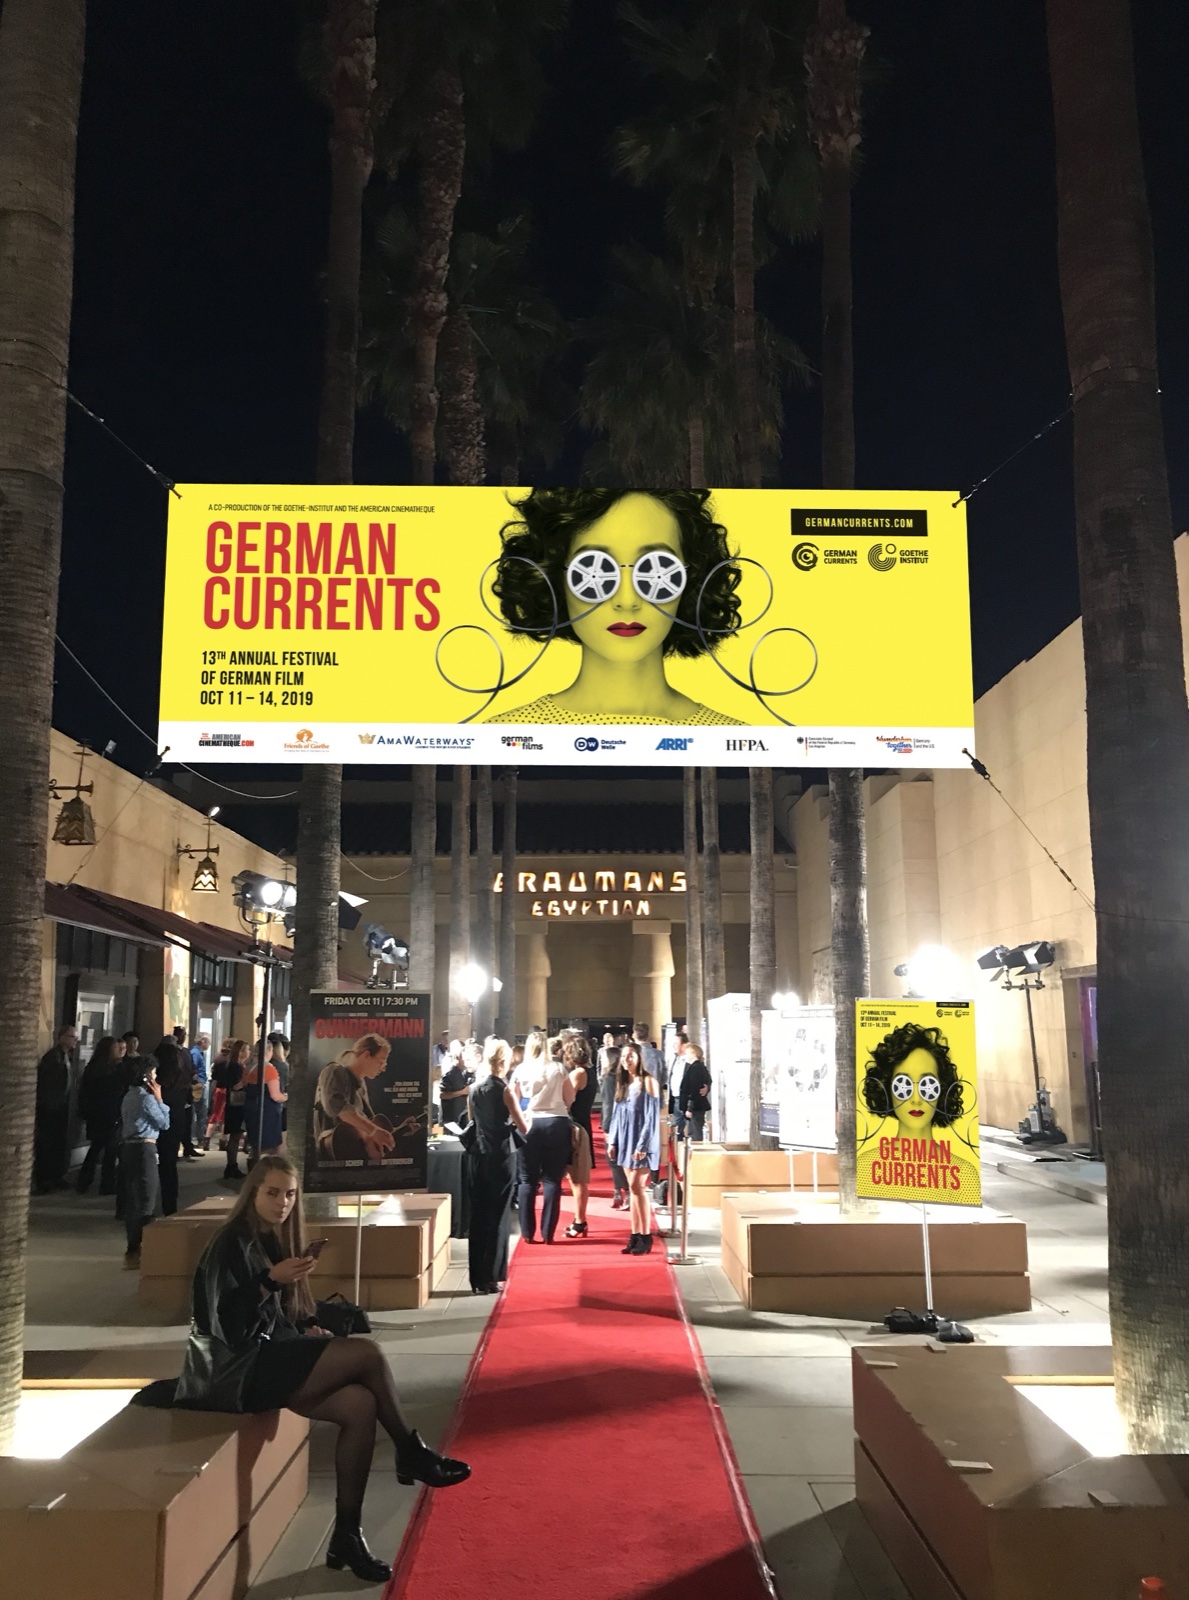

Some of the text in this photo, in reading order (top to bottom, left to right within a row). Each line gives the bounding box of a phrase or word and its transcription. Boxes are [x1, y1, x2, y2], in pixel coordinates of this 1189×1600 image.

[263, 504, 271, 512] OF
[272, 504, 283, 512] THE
[360, 505, 391, 513] AMERICAN
[805, 517, 914, 528] GERMANCURRENTS.COM
[205, 520, 397, 575] GERMAN
[823, 549, 858, 557] GERMAN
[899, 549, 929, 557] GOETHE
[203, 576, 441, 632] CURRENTS
[202, 651, 339, 666] 13TH ANNUAL FESTIVAL
[201, 670, 304, 686] OF GERMAN FILM
[200, 690, 224, 705] OCT
[281, 691, 314, 706] 2019
[198, 740, 255, 748] CINEMATHEQUE.COM
[501, 736, 533, 744] german
[522, 742, 544, 750] films
[532, 899, 650, 917] EGYPTIAN
[324, 997, 356, 1006] FRIDAY
[356, 997, 371, 1006] Oct
[372, 997, 381, 1006] 11
[386, 997, 404, 1006] 7:30
[405, 997, 419, 1006] PM
[314, 1018, 425, 1039] GUNDERMANN
[879, 1136, 951, 1165] GERMAN
[871, 1160, 961, 1191] CURRENTS
